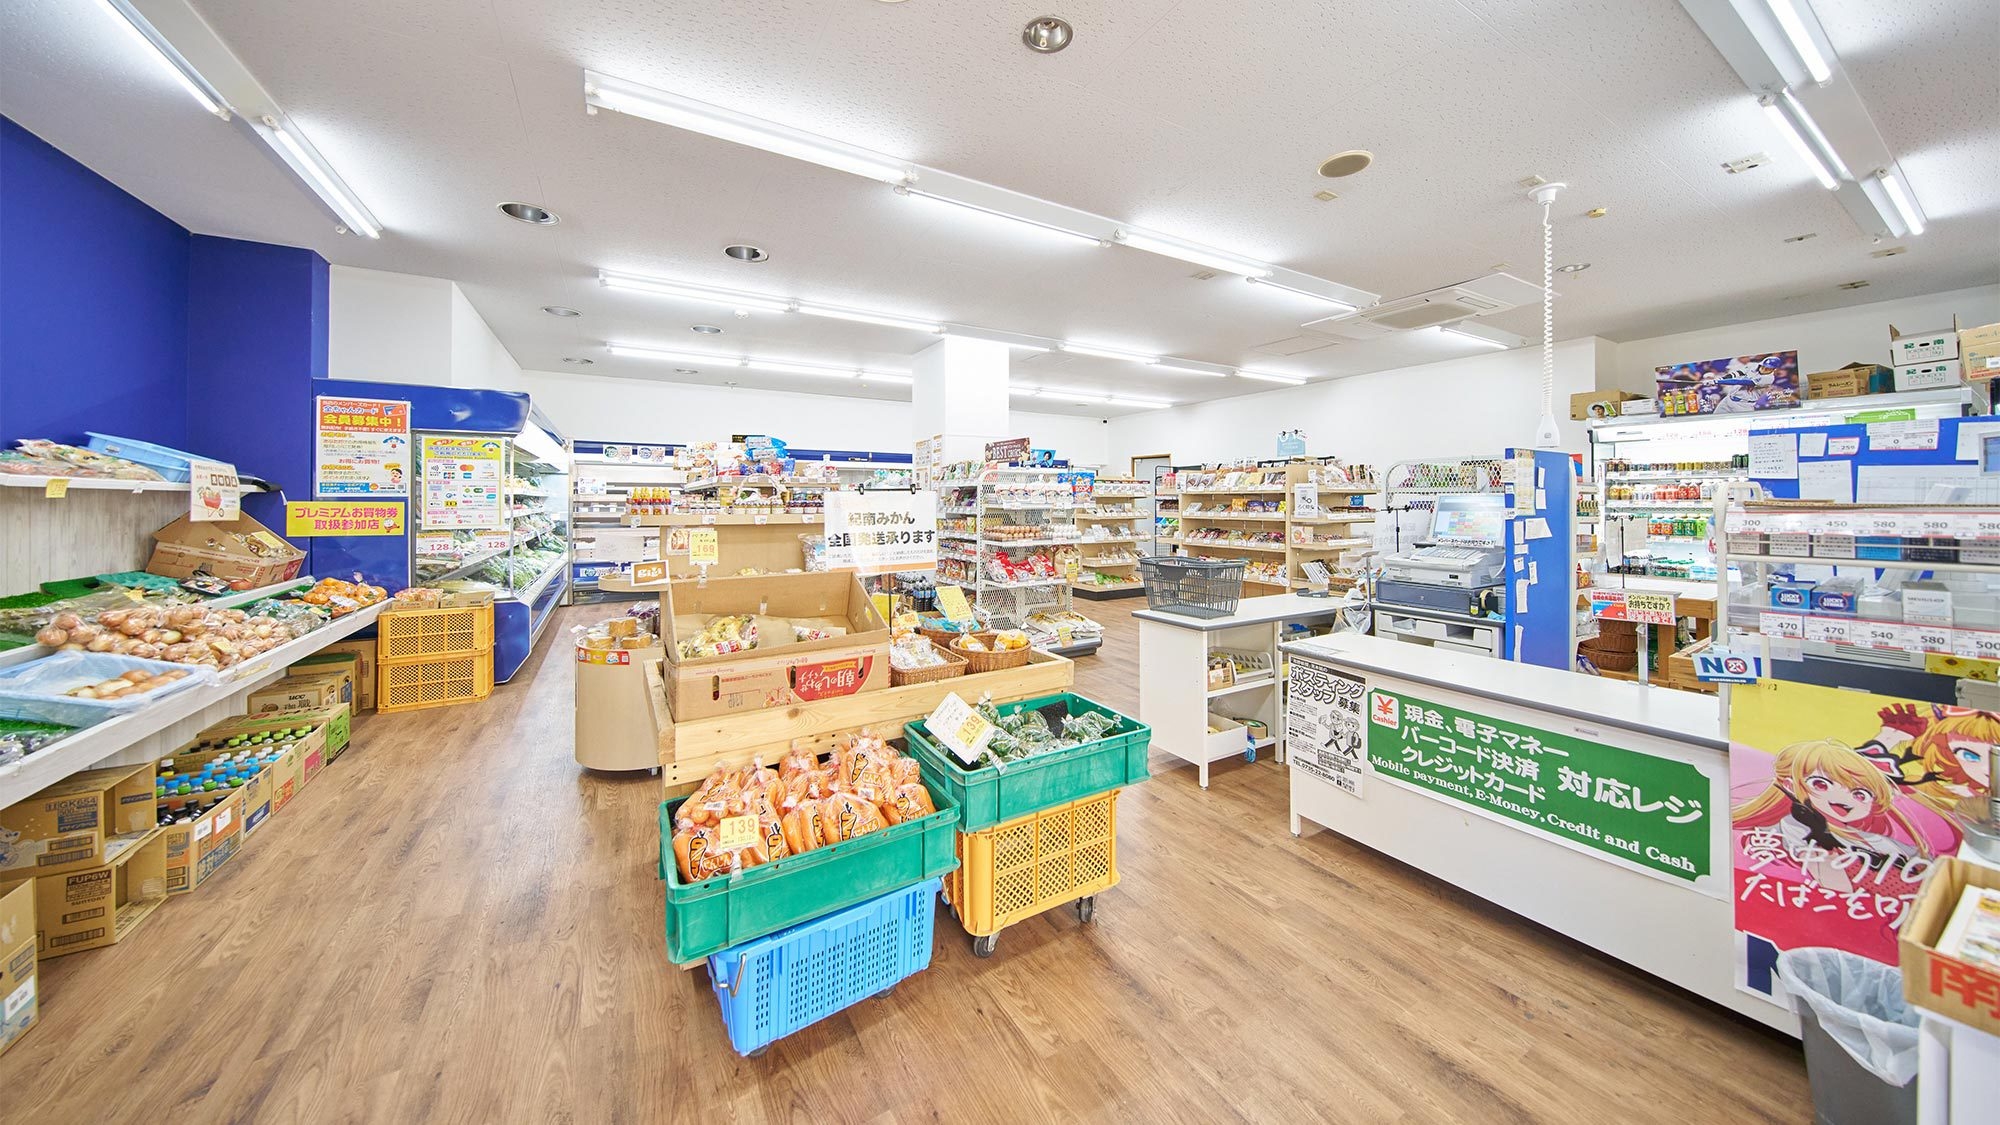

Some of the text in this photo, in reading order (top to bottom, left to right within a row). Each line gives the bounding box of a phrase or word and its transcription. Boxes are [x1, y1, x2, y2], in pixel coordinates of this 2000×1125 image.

[295, 507, 398, 519] プレミアムお買物券
[848, 511, 915, 526] 紀南みかん
[314, 519, 380, 531] 取扱参加店
[1923, 521, 1948, 529] 580
[828, 529, 935, 547] 全国発送承ります
[1777, 622, 1798, 630] 470
[1823, 627, 1845, 635] 470
[1871, 631, 1894, 639] 540
[1921, 636, 1945, 645] 580
[1976, 641, 2000, 650] 500
[801, 669, 855, 693] 朝のしあわせ
[1291, 666, 1365, 699] ポスティング
[1290, 679, 1336, 704] スタッフ
[963, 715, 980, 735] 139
[1373, 713, 1397, 727] Cashier
[1401, 725, 1540, 781] バーコード決済
[1400, 746, 1546, 804] クレジットカード
[1557, 766, 1703, 824] 対応レジ
[1372, 754, 1411, 775] Mobile
[1413, 768, 1474, 798] payment,
[1475, 788, 1546, 822] E-Money,
[1547, 812, 1601, 840] Credit
[1604, 832, 1640, 856] and
[1646, 846, 1697, 874] Cash
[730, 818, 755, 835] 139
[68, 871, 110, 885] FUP6W
